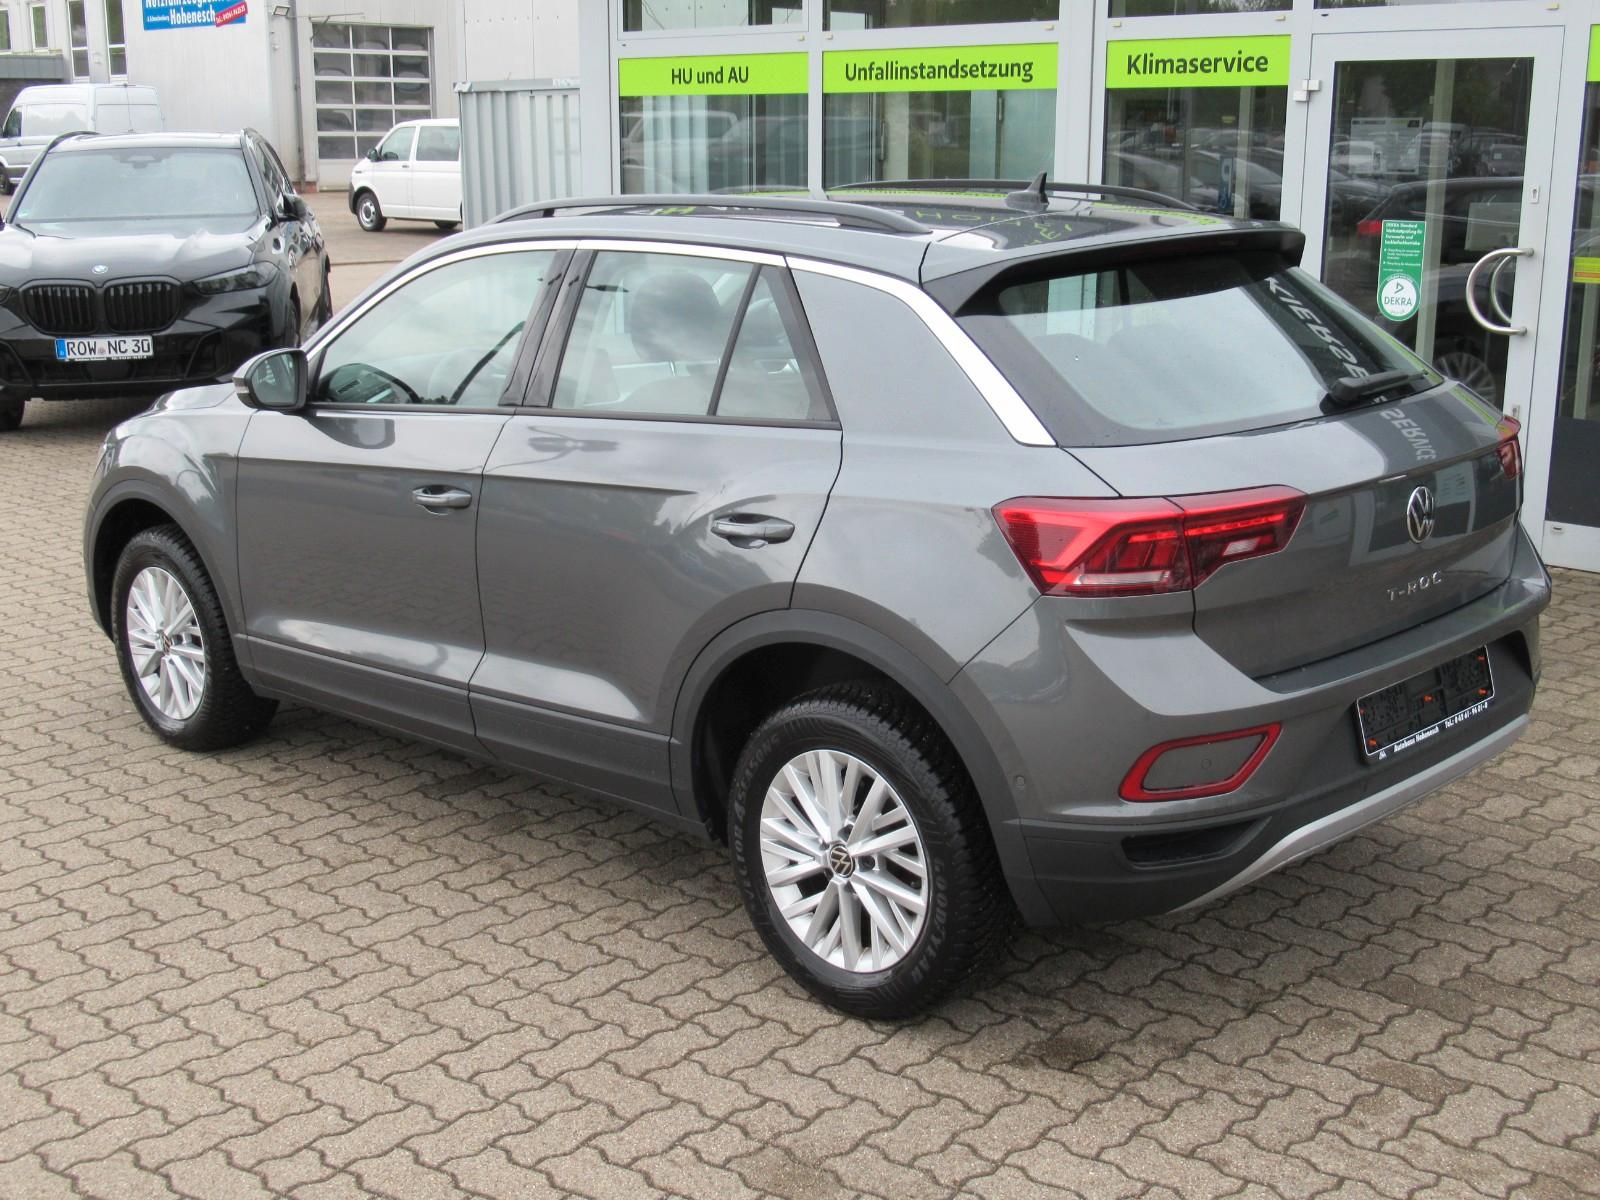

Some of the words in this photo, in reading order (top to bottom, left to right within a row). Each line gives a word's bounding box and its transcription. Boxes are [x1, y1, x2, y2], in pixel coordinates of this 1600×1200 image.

[169, 5, 216, 25] Hohenesch
[844, 59, 1034, 82] Unfallinstandsetzung
[1127, 50, 1268, 75] Klimaservice
[671, 68, 693, 85] HU
[696, 67, 724, 85] und
[728, 66, 749, 84] AU
[1384, 296, 1412, 306] DEKRA
[67, 341, 97, 356] ROW
[107, 340, 128, 355] NC
[132, 339, 150, 353] 30
[1387, 571, 1442, 601] T-ROC
